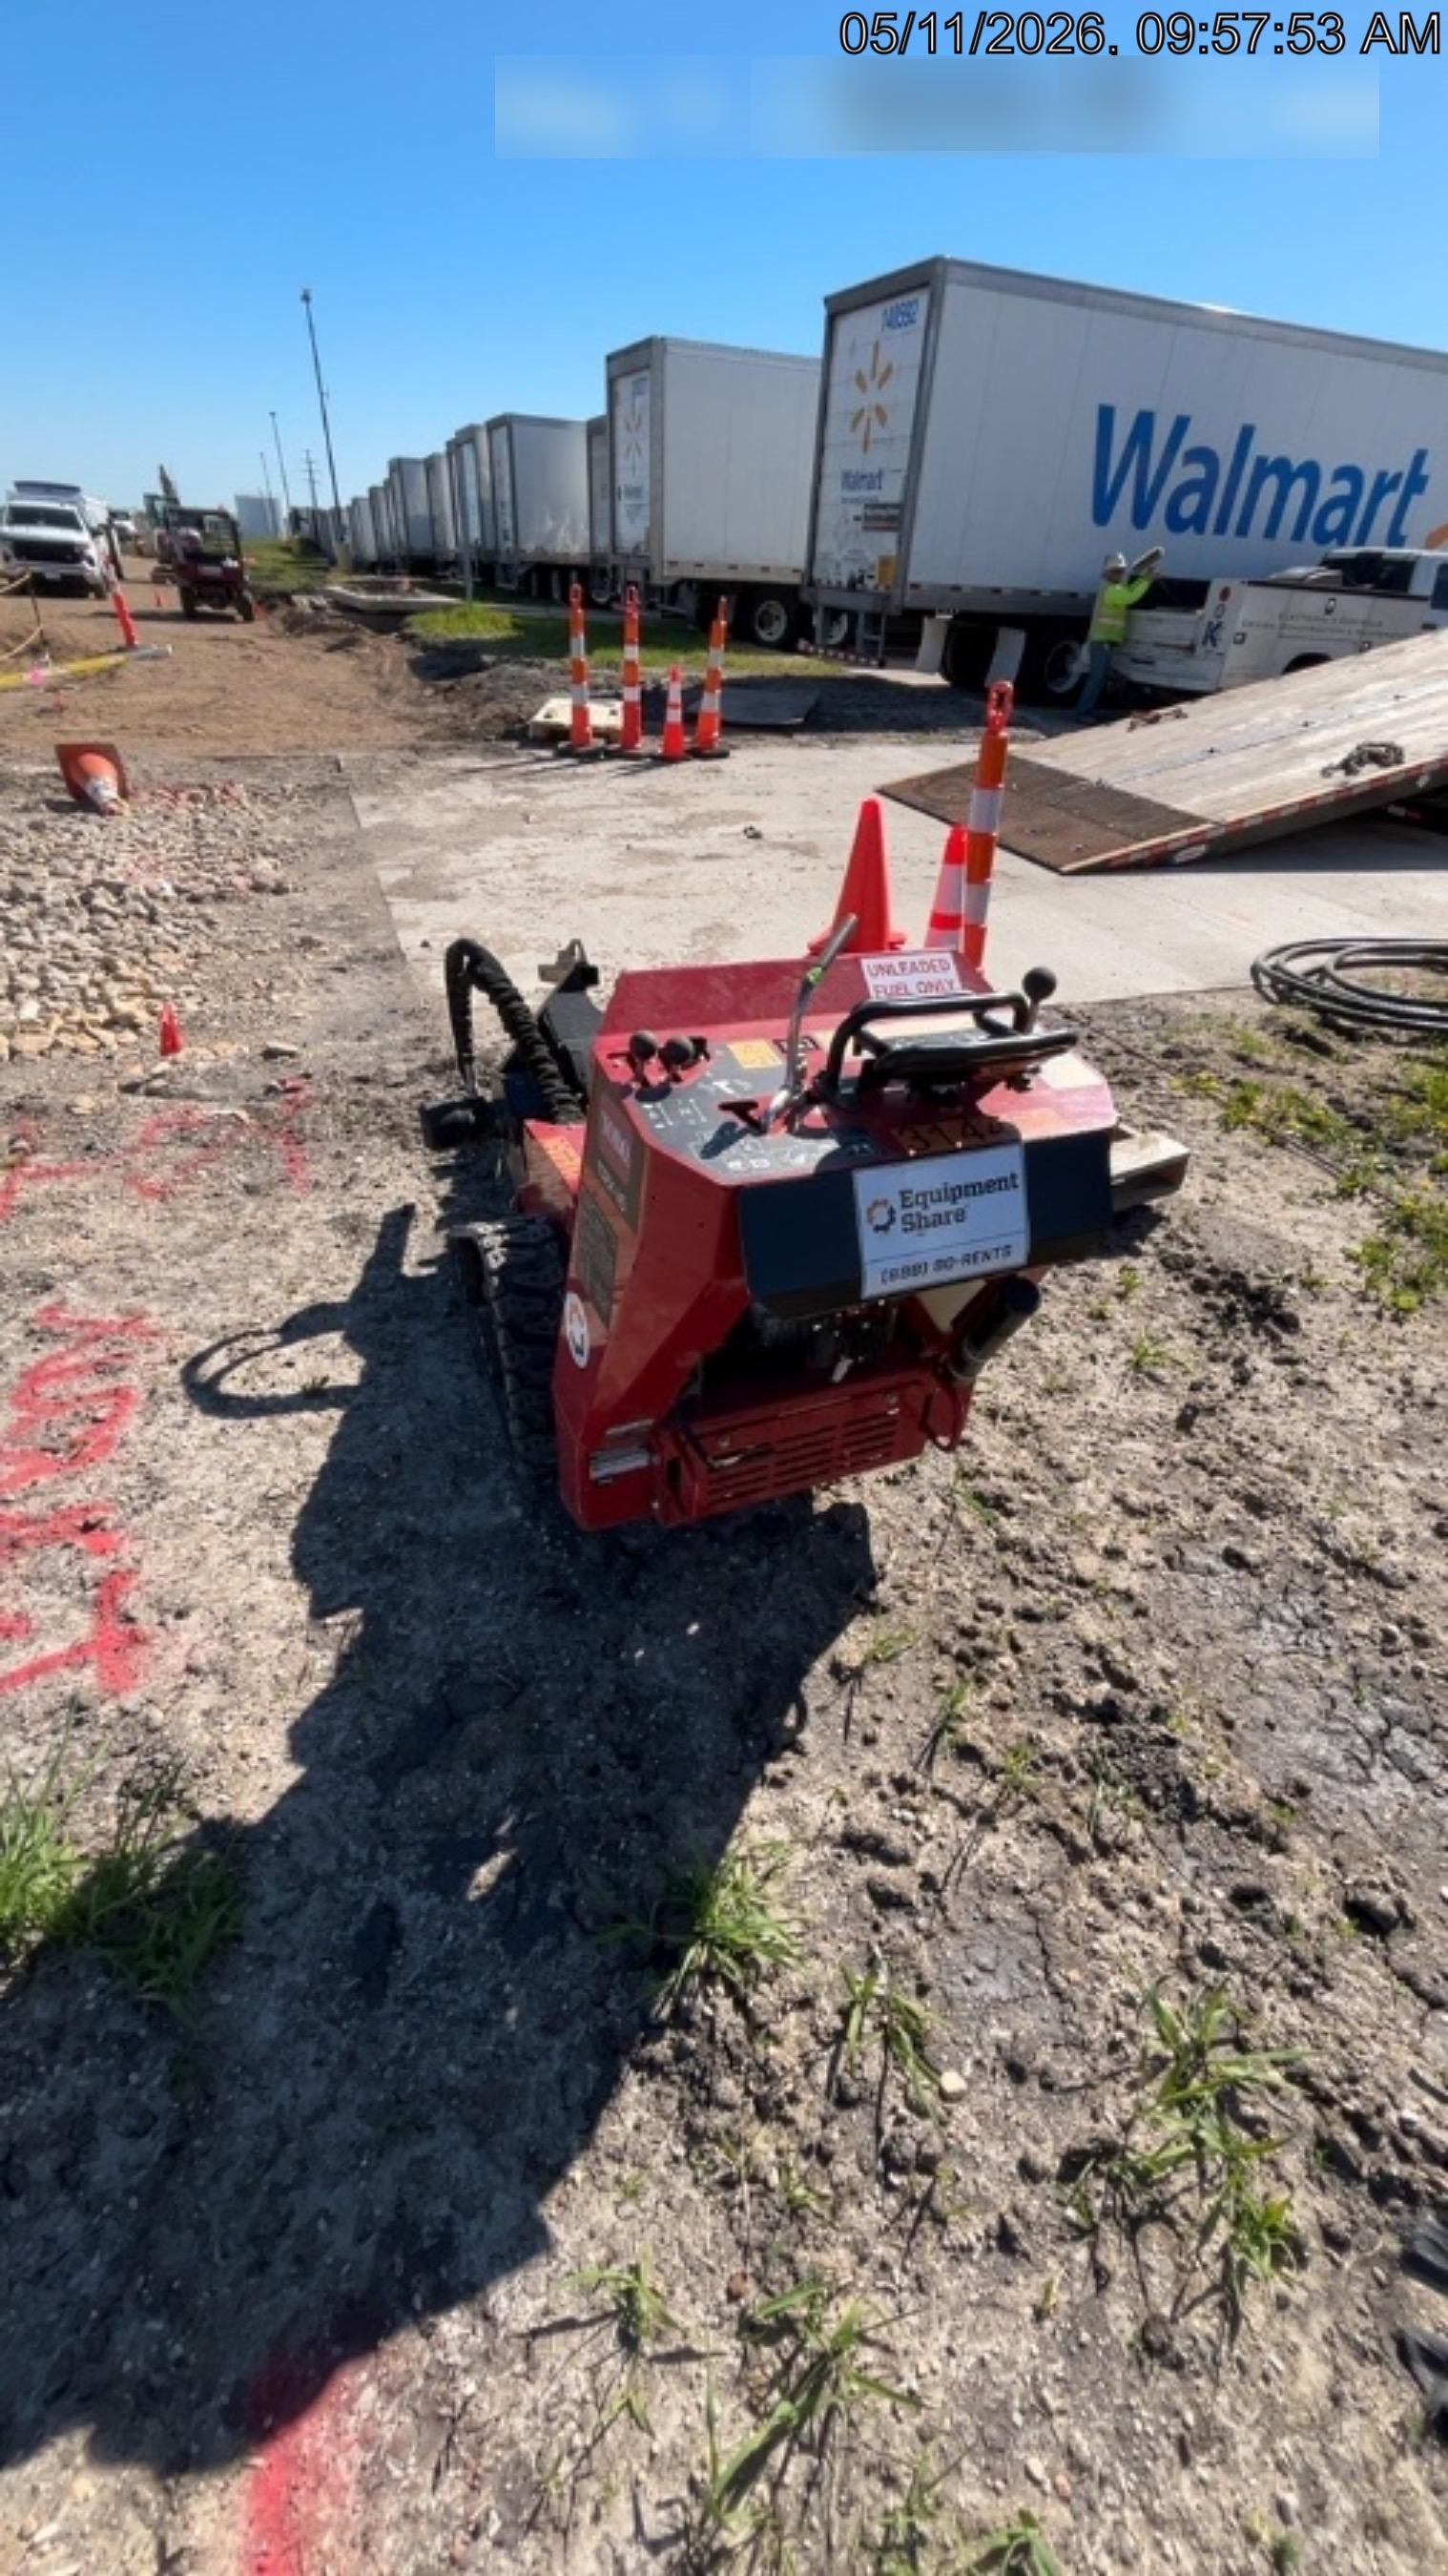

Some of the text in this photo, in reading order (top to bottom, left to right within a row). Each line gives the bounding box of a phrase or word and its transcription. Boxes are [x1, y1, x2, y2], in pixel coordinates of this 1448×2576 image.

[1092, 404, 1429, 548] Walmart
[866, 958, 950, 977] UNLEADED
[872, 978, 954, 996] FUEL ONLY
[899, 1173, 1020, 1211] Equipment
[900, 1208, 967, 1234] Share
